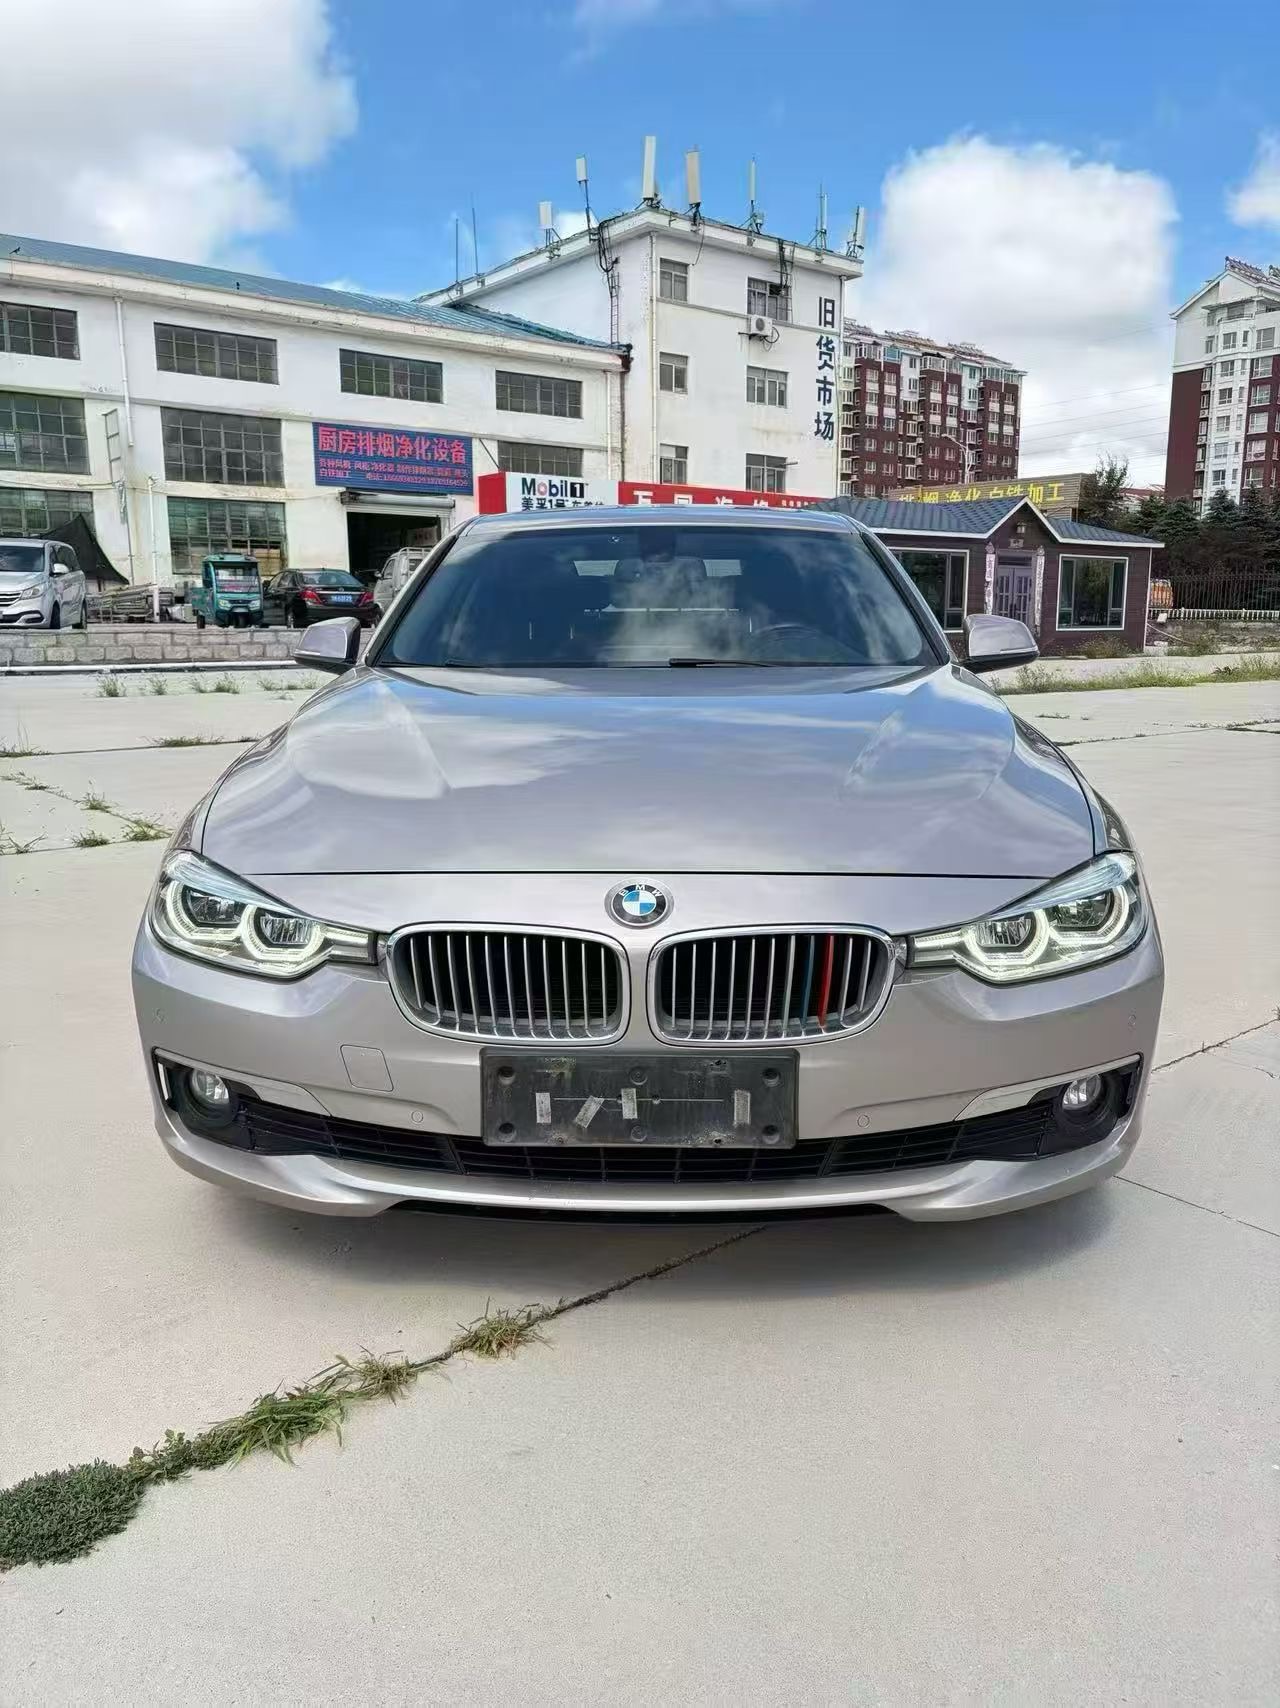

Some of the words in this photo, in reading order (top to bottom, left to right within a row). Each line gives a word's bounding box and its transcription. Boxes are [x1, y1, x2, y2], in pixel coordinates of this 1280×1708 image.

[814, 296, 835, 441] 旧货市场
[318, 426, 466, 464] 厨房排烟净化设备
[521, 477, 568, 497] Mobil
[618, 883, 663, 896] BMW
